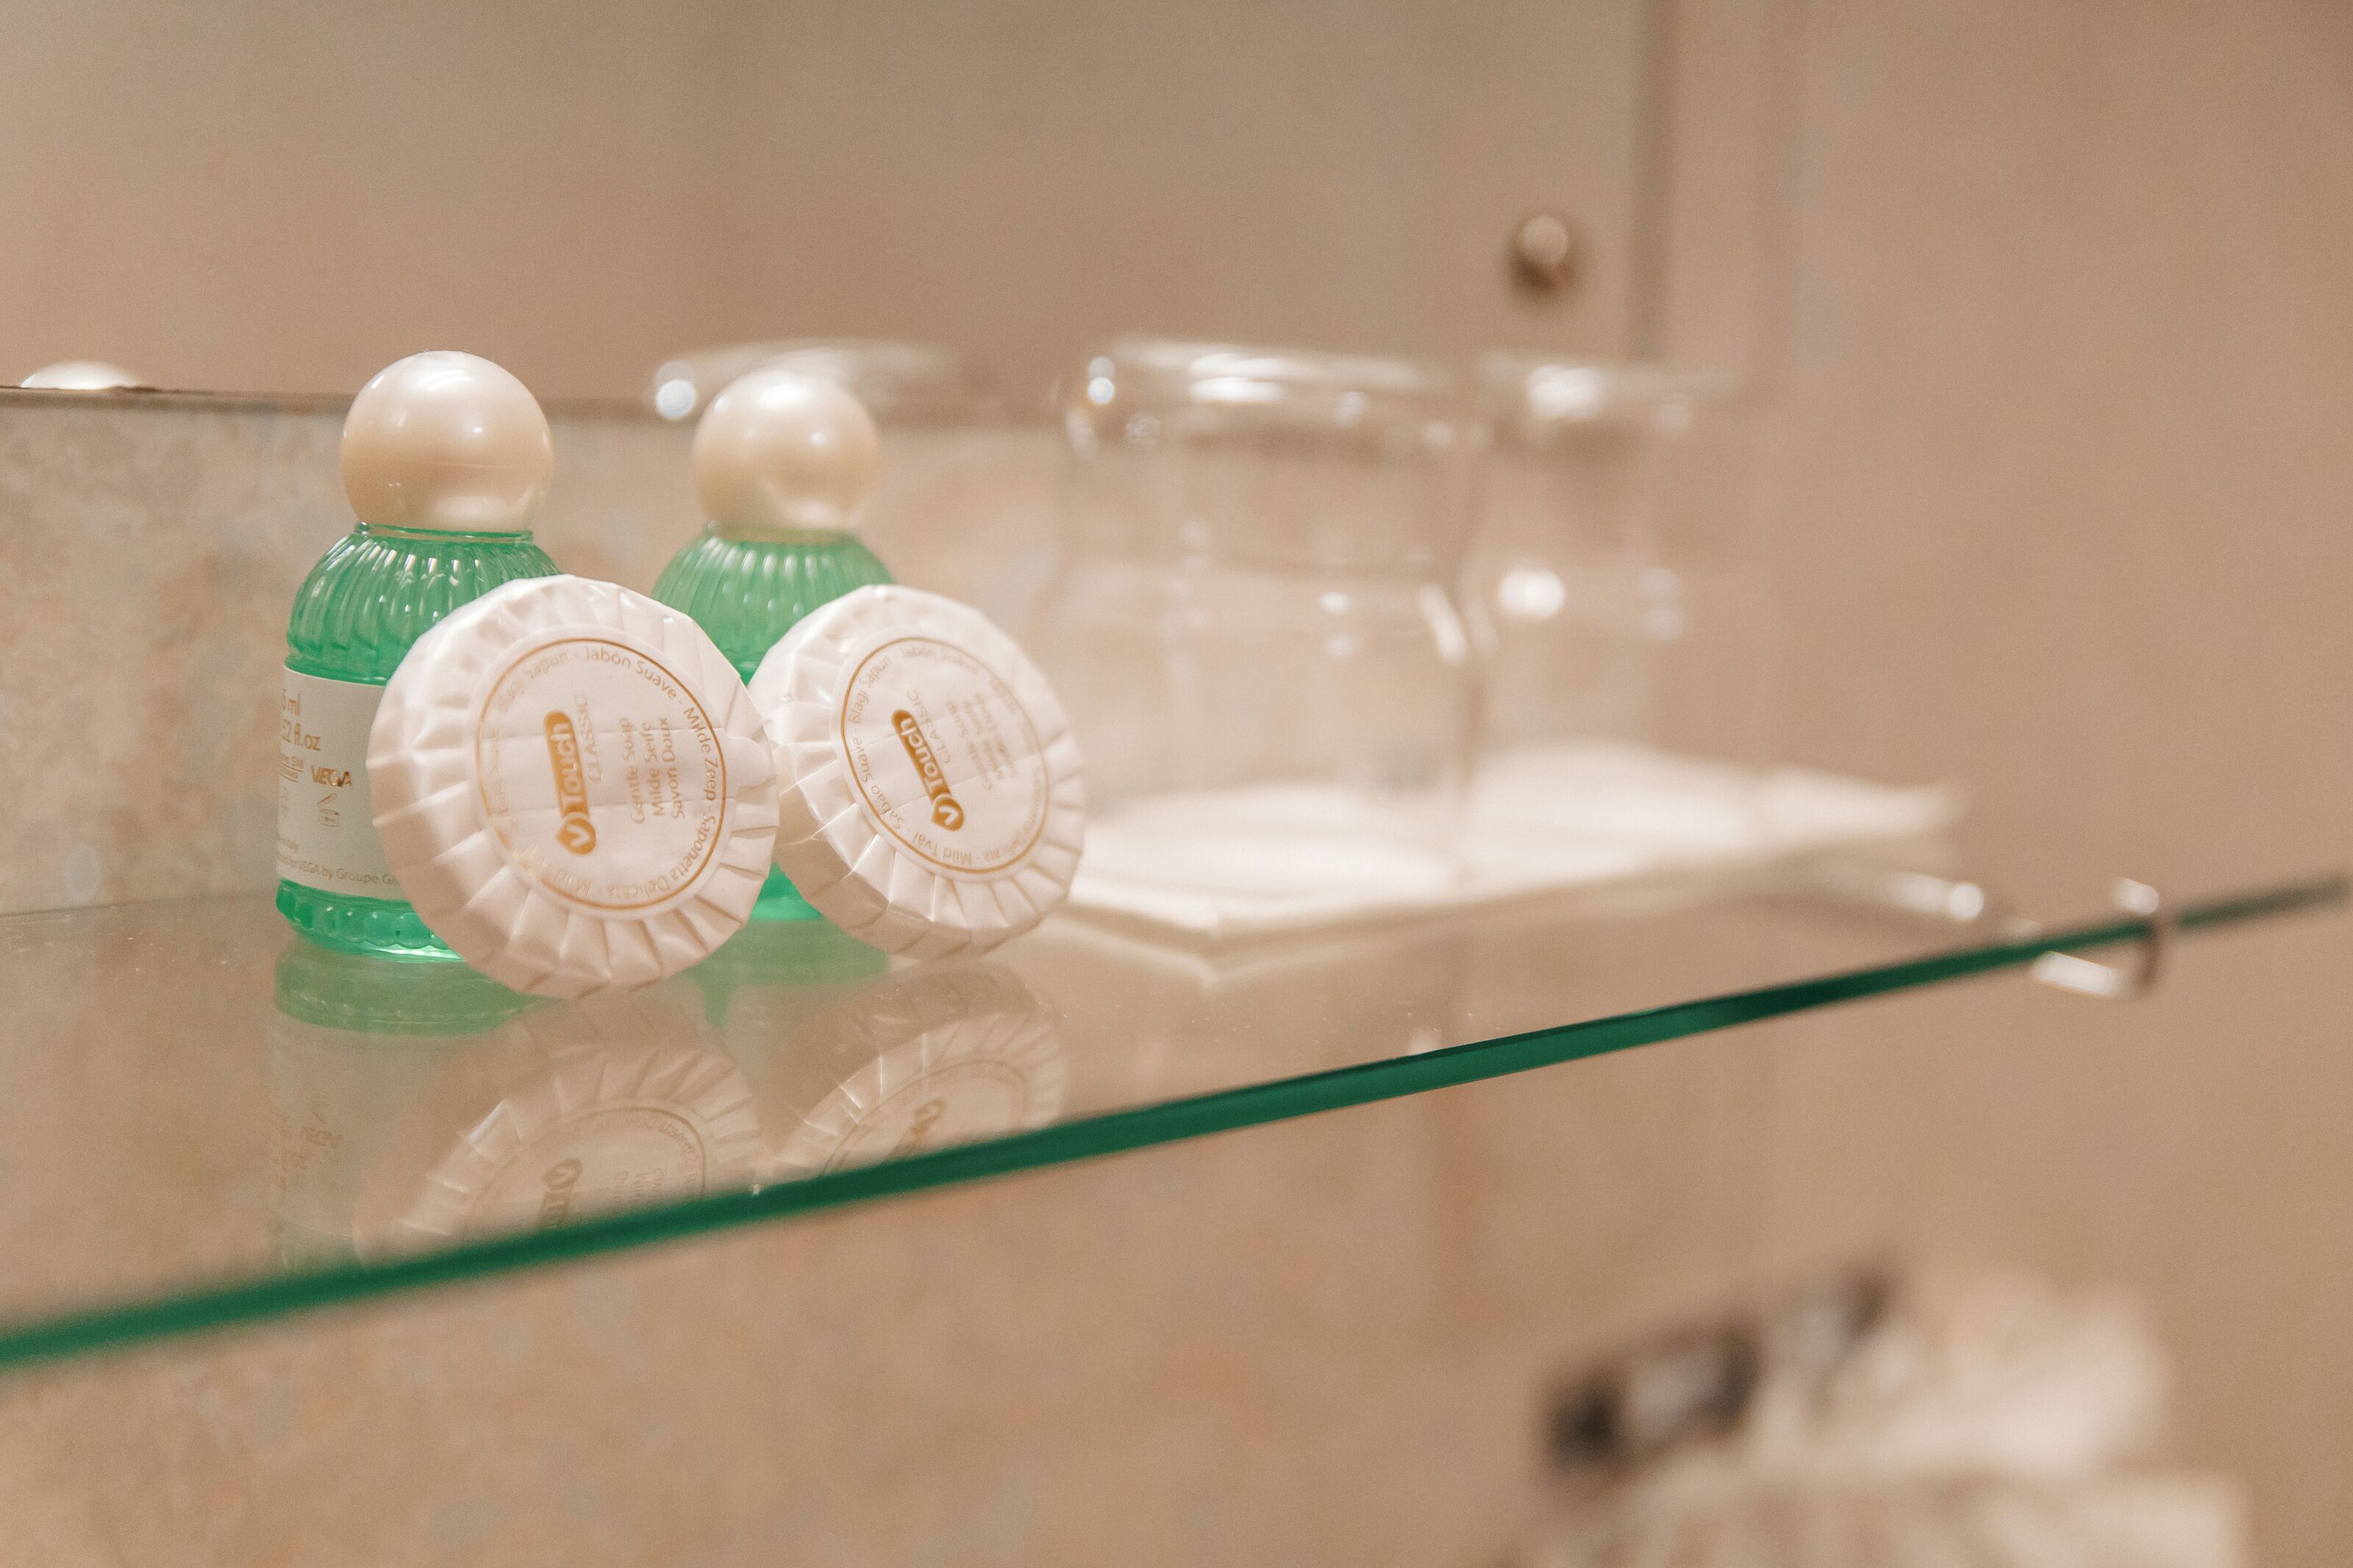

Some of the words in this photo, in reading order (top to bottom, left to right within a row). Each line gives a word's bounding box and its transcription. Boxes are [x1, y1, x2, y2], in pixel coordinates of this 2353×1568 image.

[585, 647, 632, 670] Jabón
[635, 661, 677, 699] Suave
[848, 690, 870, 724] Blagi
[860, 656, 892, 688] Sapun
[574, 694, 601, 783] CLASSIC
[619, 717, 636, 761] Soap
[640, 722, 657, 763] Seife
[660, 717, 675, 762] Doux
[906, 689, 951, 764] CLASSIC
[311, 765, 354, 789] VEGA
[551, 722, 584, 804] Touch
[683, 706, 712, 754] Milde
[703, 758, 718, 801] Zeep
[853, 737, 874, 783] Suave
[899, 717, 944, 794] Touch
[626, 765, 645, 823] Gentle
[647, 769, 665, 816] Milde
[667, 768, 685, 820] Savon
[670, 812, 716, 881] Saponetta
[943, 848, 971, 865] Mild
[322, 868, 335, 881] by
[336, 868, 379, 885] Groupe
